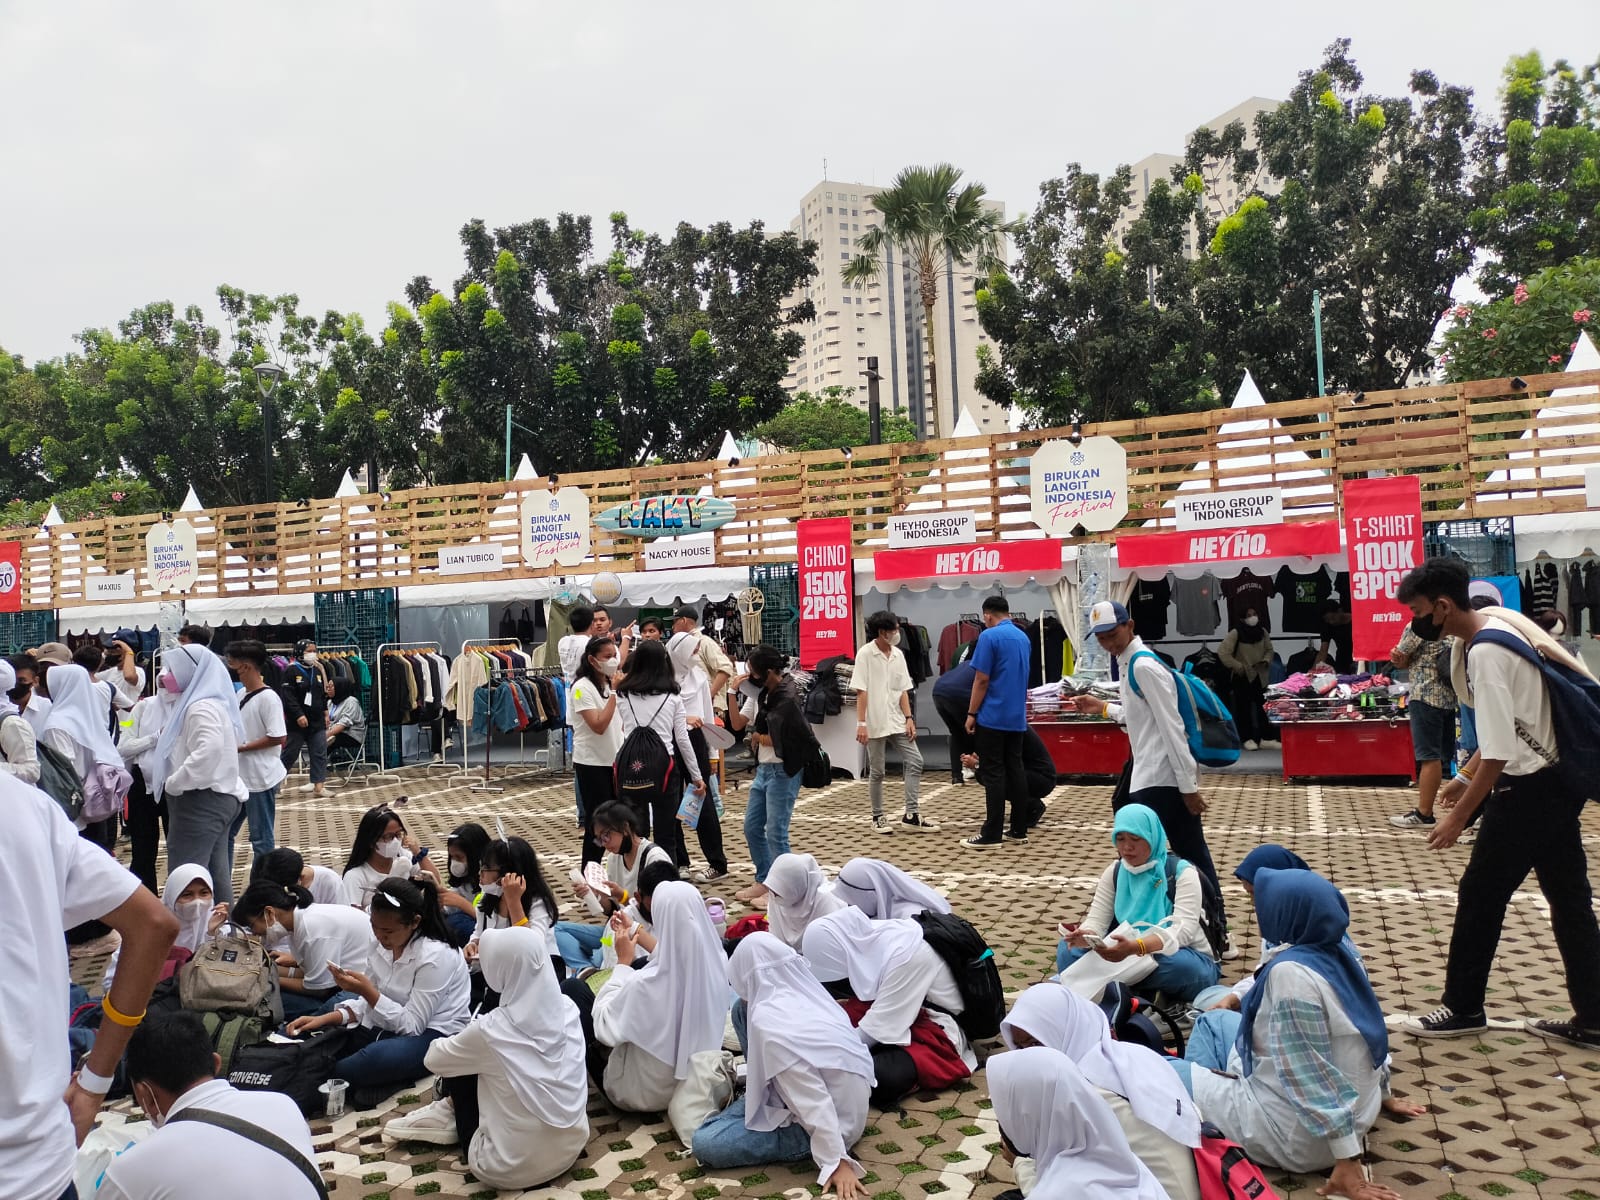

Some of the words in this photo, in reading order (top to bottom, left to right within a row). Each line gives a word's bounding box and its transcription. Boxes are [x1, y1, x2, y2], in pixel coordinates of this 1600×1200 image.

[1044, 468, 1100, 482] BIRUKAN
[1044, 480, 1089, 493] LANGIT
[1045, 489, 1113, 504] INDONESIA
[1183, 499, 1226, 512] HEYHO
[1229, 495, 1274, 508] GROUP
[618, 497, 708, 528] NAKY
[1048, 491, 1116, 527] Festival
[1194, 506, 1264, 521] INDONESIA
[531, 513, 571, 525] BIRUKAN
[894, 520, 930, 532] HEYHO
[932, 517, 969, 529] GROUP
[1352, 514, 1415, 538] T-SHIRT
[531, 523, 564, 534] LANGIT
[903, 527, 960, 540] INDONESIA
[531, 531, 580, 543] INDONESIA
[1189, 529, 1267, 560] HEYHO
[153, 544, 184, 554] BIRUKAN
[533, 533, 582, 562] Festival
[648, 550, 680, 560] NACKY
[680, 546, 711, 557] HOUSE
[154, 553, 178, 562] LANGIT
[446, 555, 465, 565] LIAN
[465, 553, 495, 563] TUBICO
[804, 544, 846, 568] CHINO
[935, 546, 1001, 575] HEYHO
[1353, 540, 1415, 571] 100K
[154, 560, 191, 570] INDONESIA
[97, 583, 122, 592] MAXIUS
[803, 570, 847, 596] 150K
[1352, 570, 1413, 601] 3PC
[802, 594, 848, 620] 2PCS
